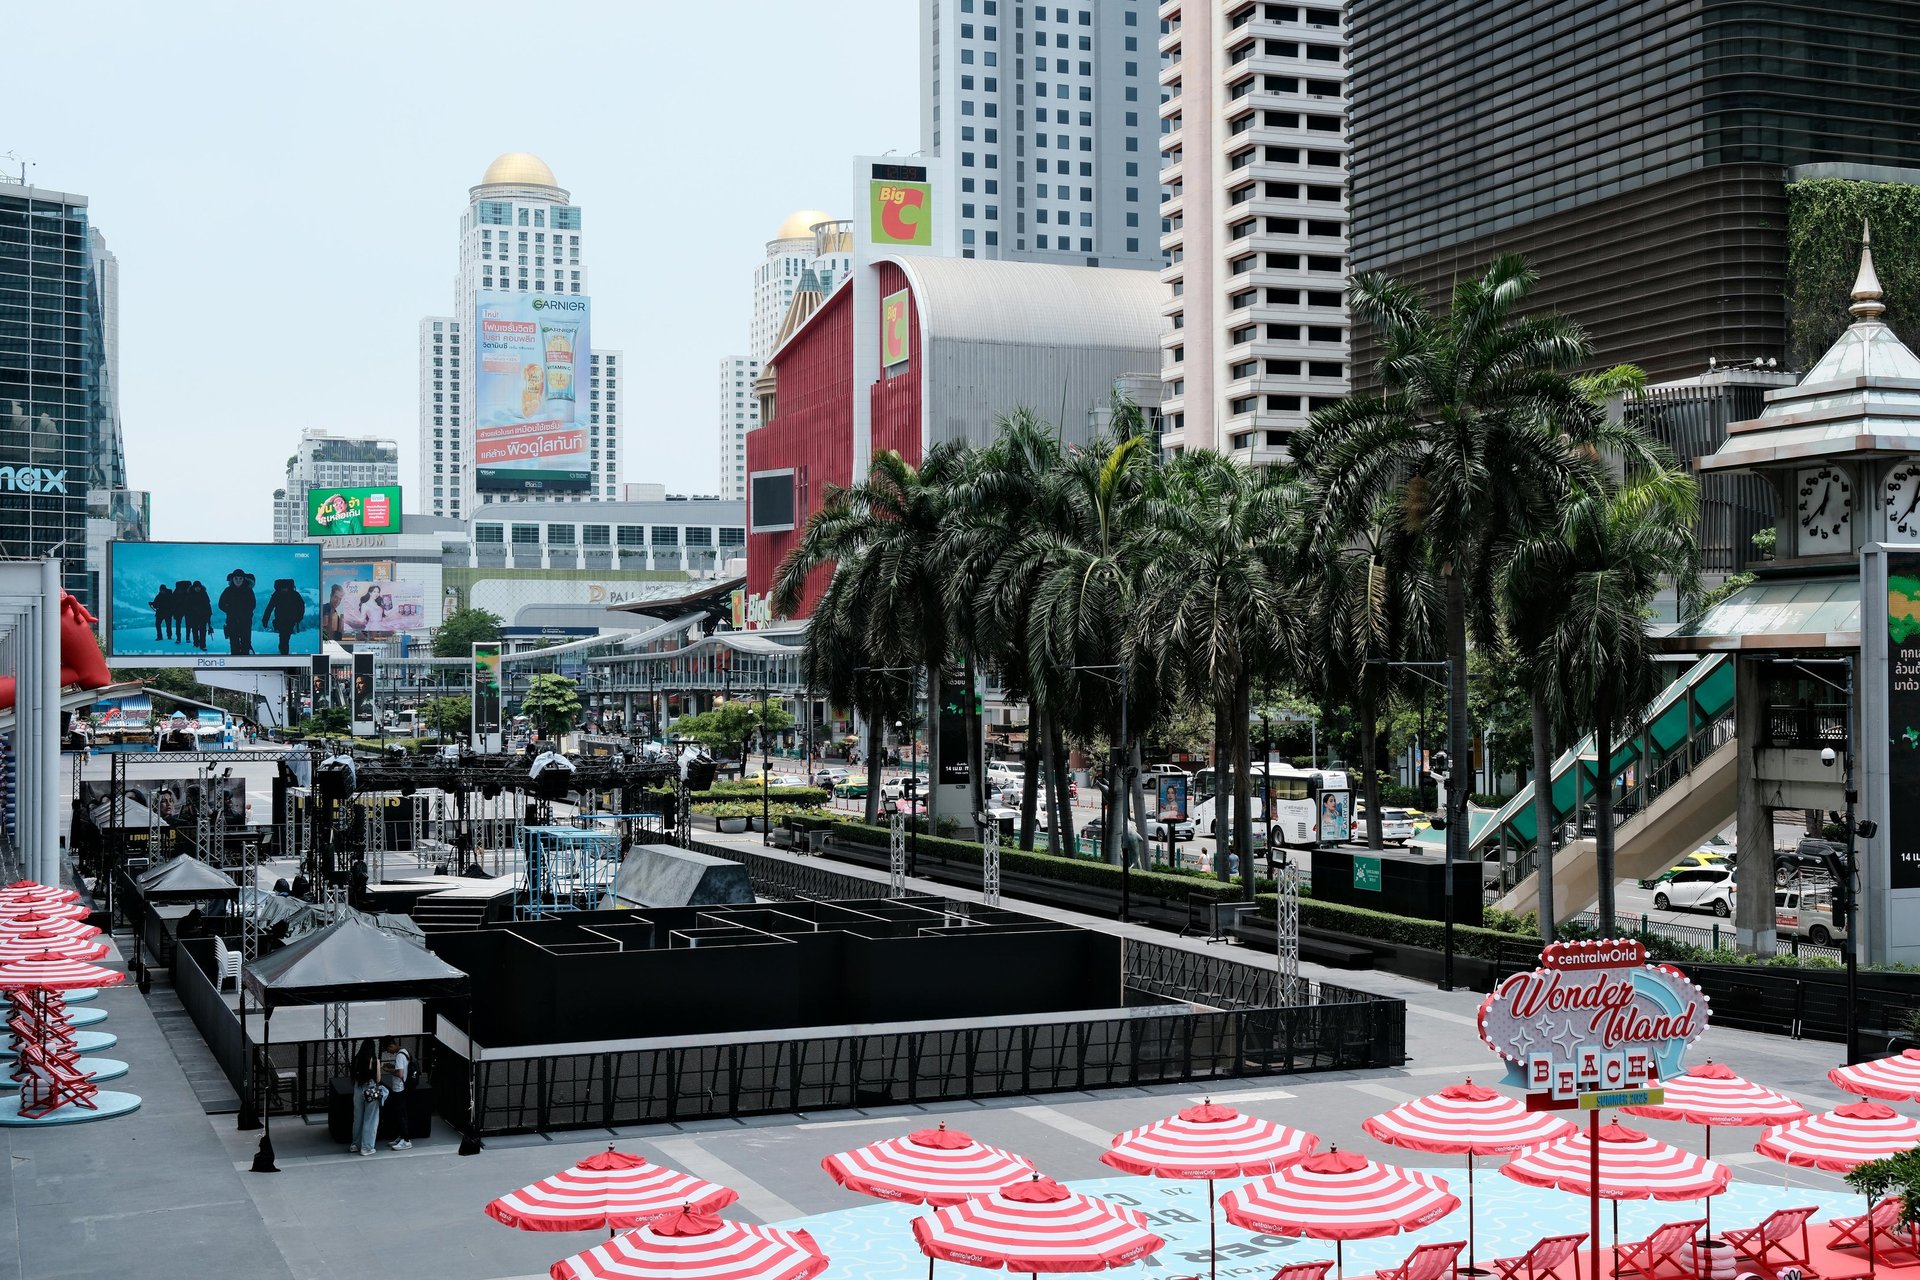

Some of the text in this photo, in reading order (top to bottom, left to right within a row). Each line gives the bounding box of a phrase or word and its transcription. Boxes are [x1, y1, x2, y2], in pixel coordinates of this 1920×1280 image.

[879, 186, 906, 205] Big
[881, 188, 925, 241] C
[532, 299, 586, 312] GARNIER
[886, 304, 897, 322] Big
[887, 301, 905, 358] C
[507, 434, 584, 457] ผิวดูใสทันที
[320, 535, 386, 549] PALLADIUM
[1894, 677, 1920, 691] มาด้ว
[1900, 852, 1911, 862] 14
[1558, 947, 1638, 966] centralwOrld
[1499, 970, 1636, 1019] Wonder
[1588, 998, 1697, 1050] Island
[1533, 1054, 1647, 1093] BEACH
[1596, 1093, 1629, 1107] SUMMER
[1181, 1168, 1216, 1176] centralwOrld
[949, 1249, 983, 1263] centralwOrld
